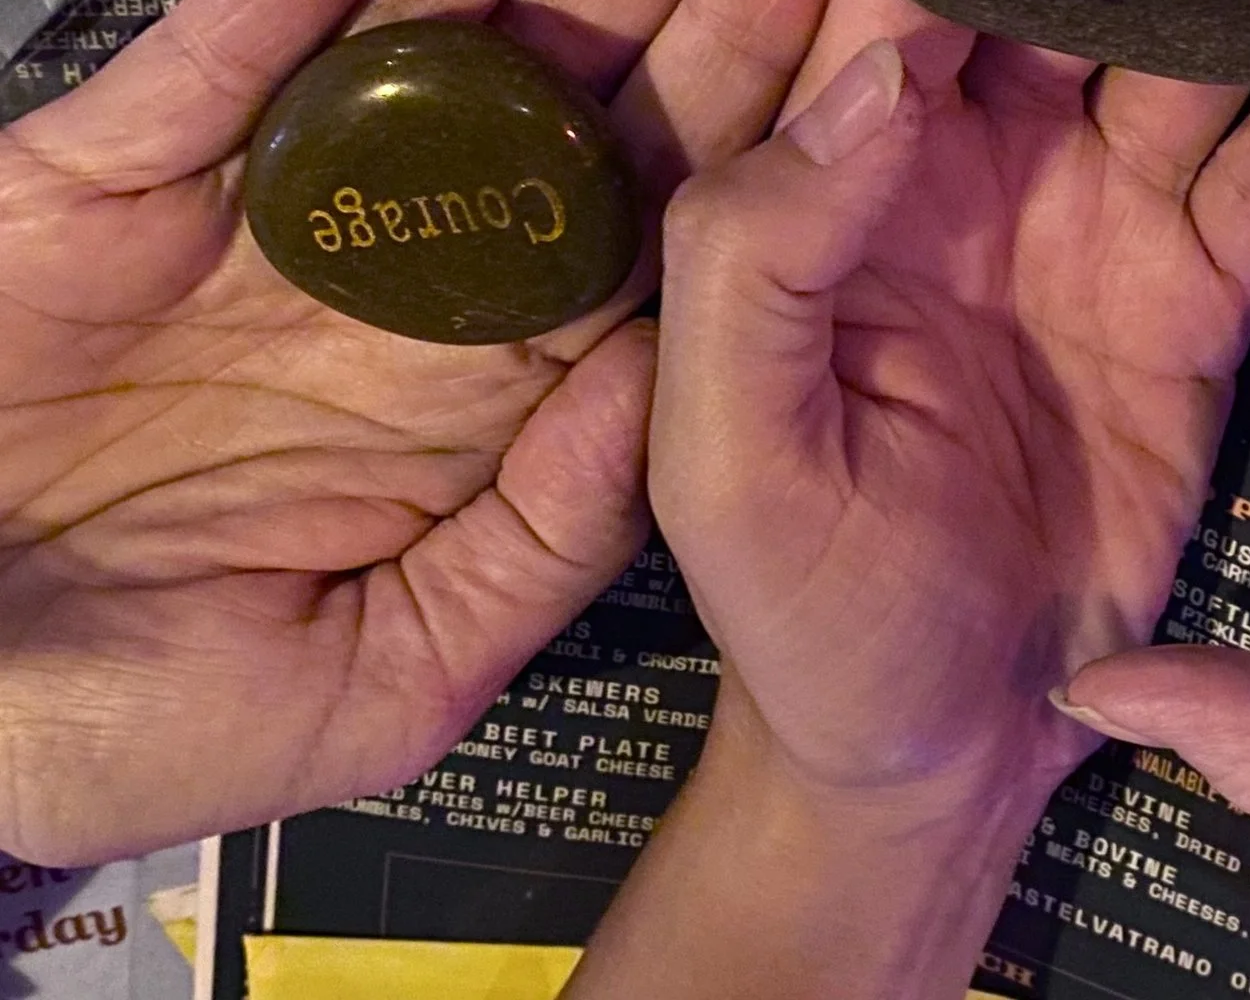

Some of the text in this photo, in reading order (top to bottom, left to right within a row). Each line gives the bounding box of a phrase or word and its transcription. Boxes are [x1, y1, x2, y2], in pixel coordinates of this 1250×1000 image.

[308, 178, 566, 253] Courage
[528, 672, 662, 706] SKEWERS
[562, 698, 631, 721] SALSA
[643, 707, 712, 730] VERDE
[483, 722, 672, 763] BEET PLATE
[528, 749, 583, 771] GOAT
[595, 757, 677, 781] CHEESE
[410, 770, 476, 794] VER
[495, 778, 608, 809] HELPER
[418, 788, 485, 813] FRIES
[588, 810, 660, 832] CHEES
[1087, 771, 1193, 831] DIVINE
[445, 810, 526, 835] CHIVES
[563, 826, 645, 849] GARLIC
[1045, 839, 1113, 879] MEATS
[1122, 870, 1138, 890] &
[1073, 827, 1179, 886] BOVINE
[1174, 831, 1242, 874] DRIED
